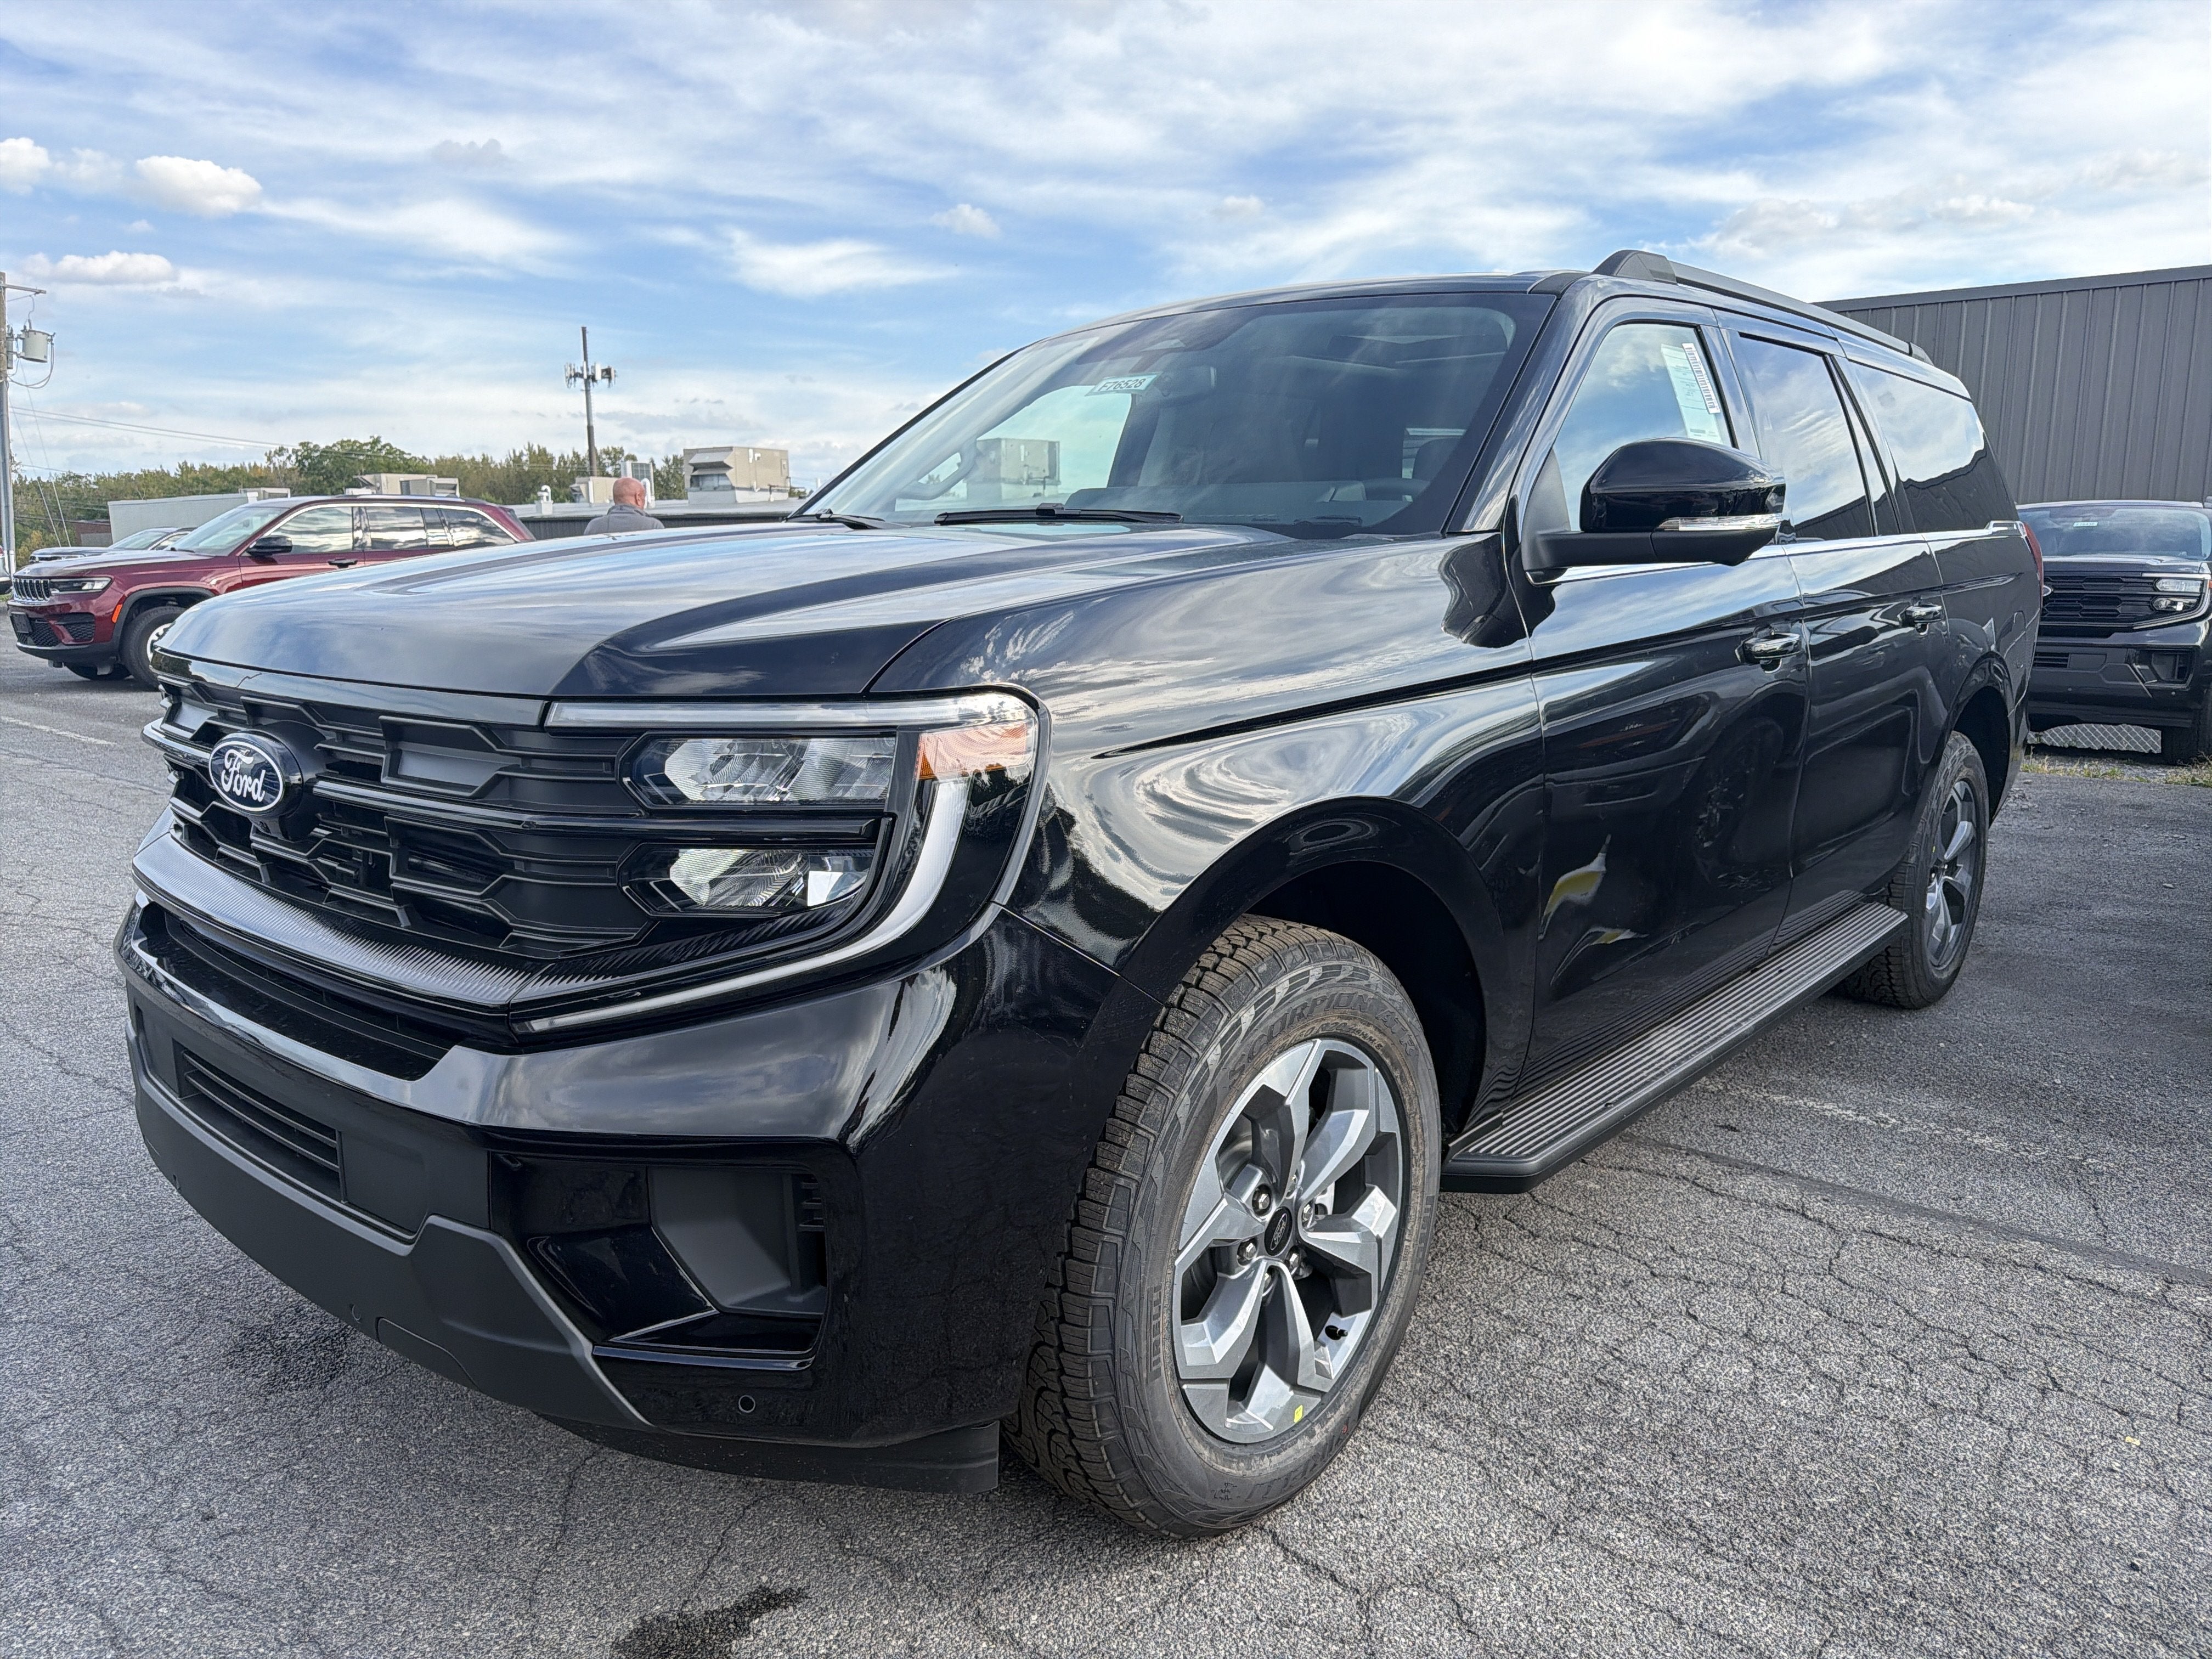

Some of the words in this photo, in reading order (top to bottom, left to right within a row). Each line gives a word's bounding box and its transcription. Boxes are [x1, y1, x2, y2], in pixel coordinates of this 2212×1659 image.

[1098, 378, 1147, 392] F76528
[221, 749, 266, 803] Ford
[1228, 992, 1372, 1089] SCORPION
[1273, 1220, 1285, 1245] Ford
[1146, 1284, 1162, 1384] PIRELLI
